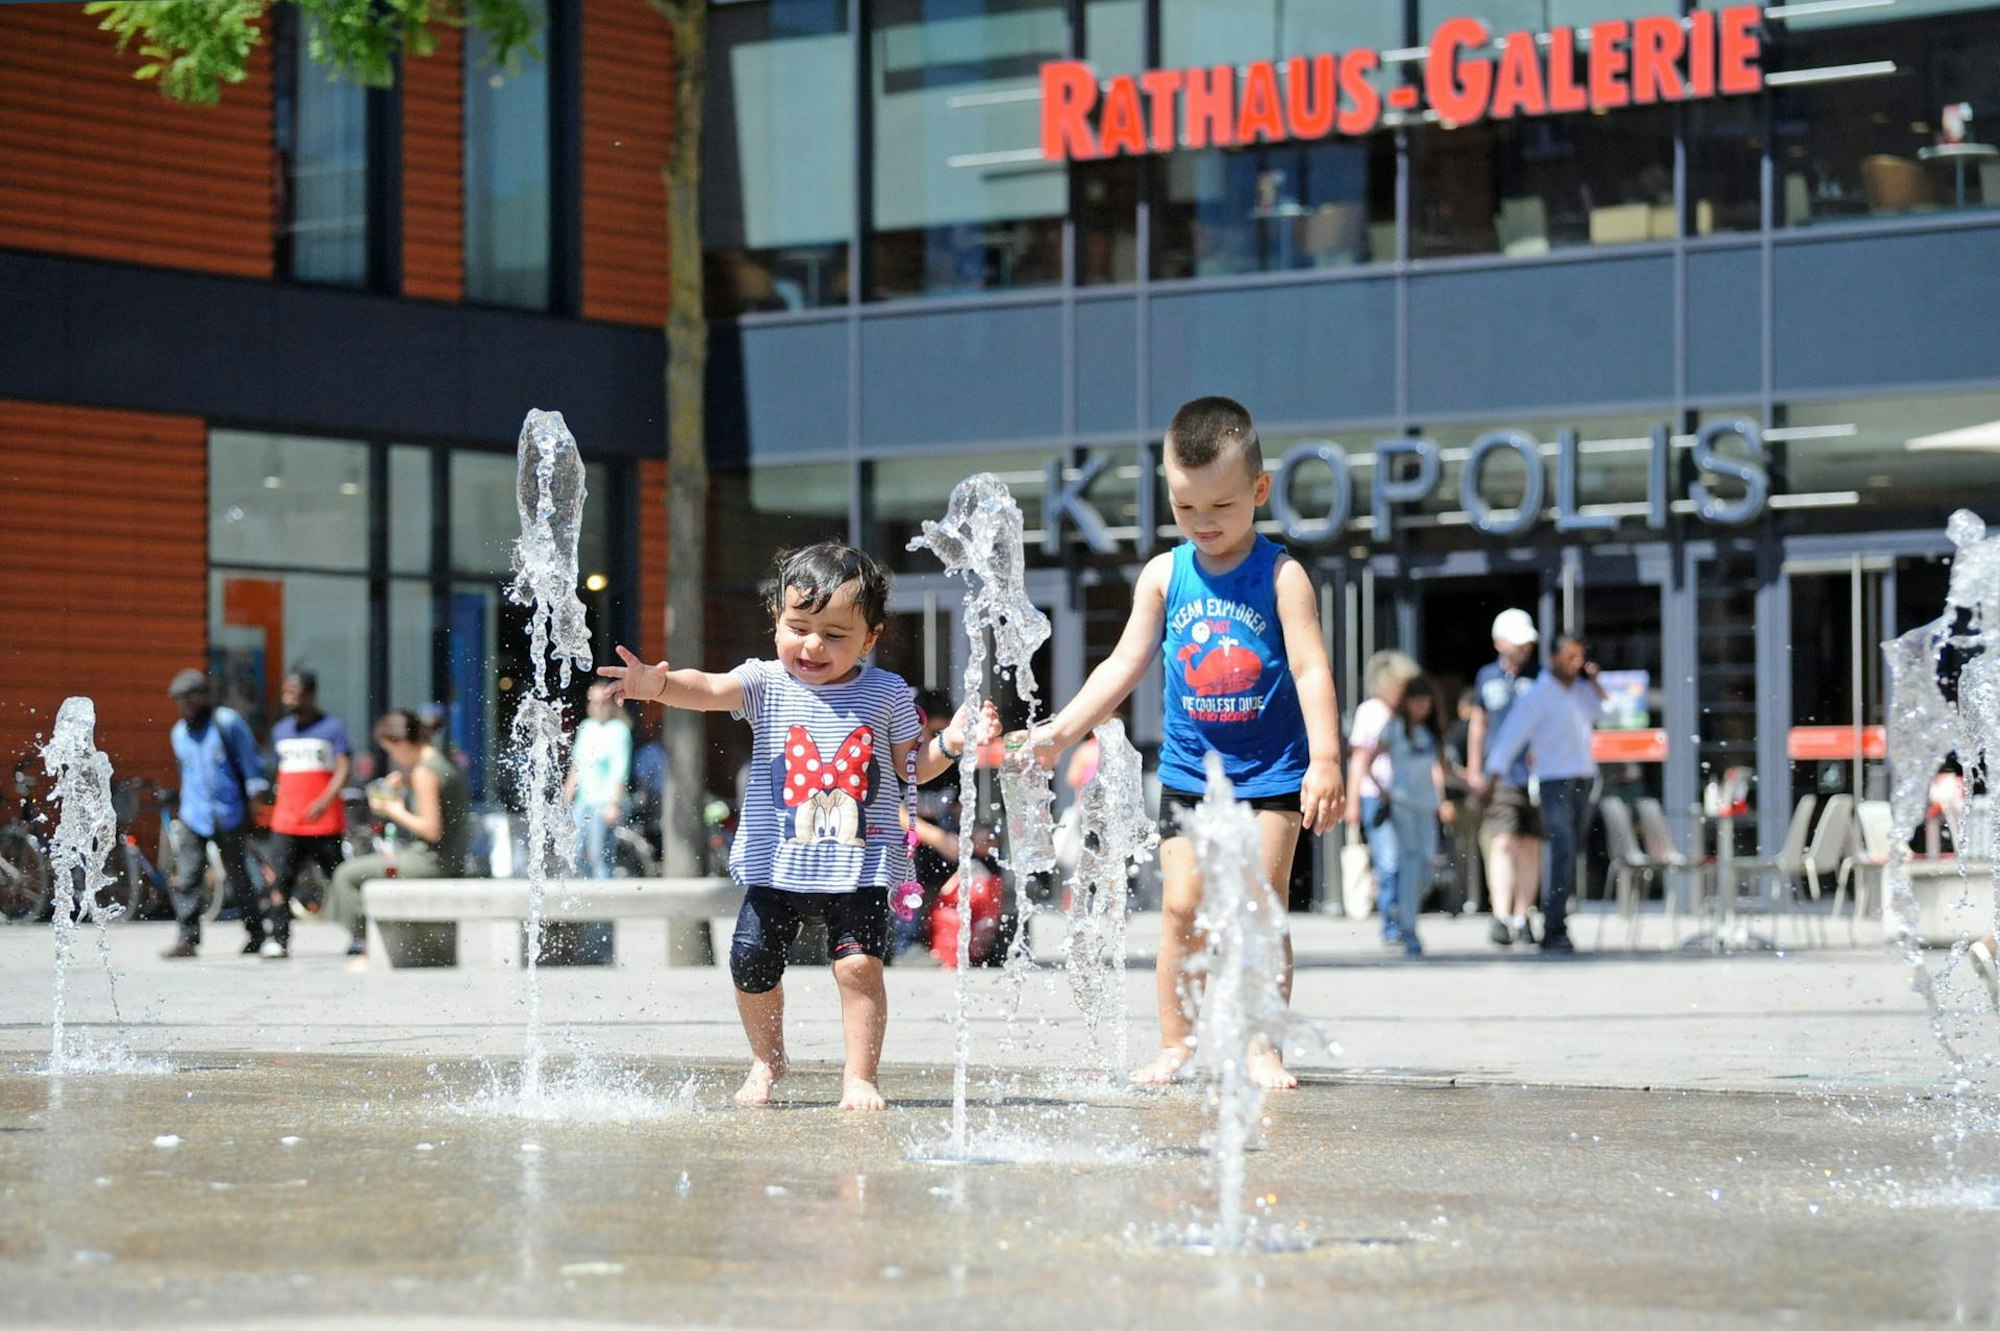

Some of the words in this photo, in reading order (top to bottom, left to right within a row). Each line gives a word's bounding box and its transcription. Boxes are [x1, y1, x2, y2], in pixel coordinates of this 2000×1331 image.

[1040, 5, 1763, 161] RATHAUS-GALERIE
[1040, 414, 1769, 557] KIOPOLIS
[1206, 598, 1267, 636] EXPLORER
[1195, 696, 1236, 713] COOLEST
[1239, 696, 1264, 710] DUDE
